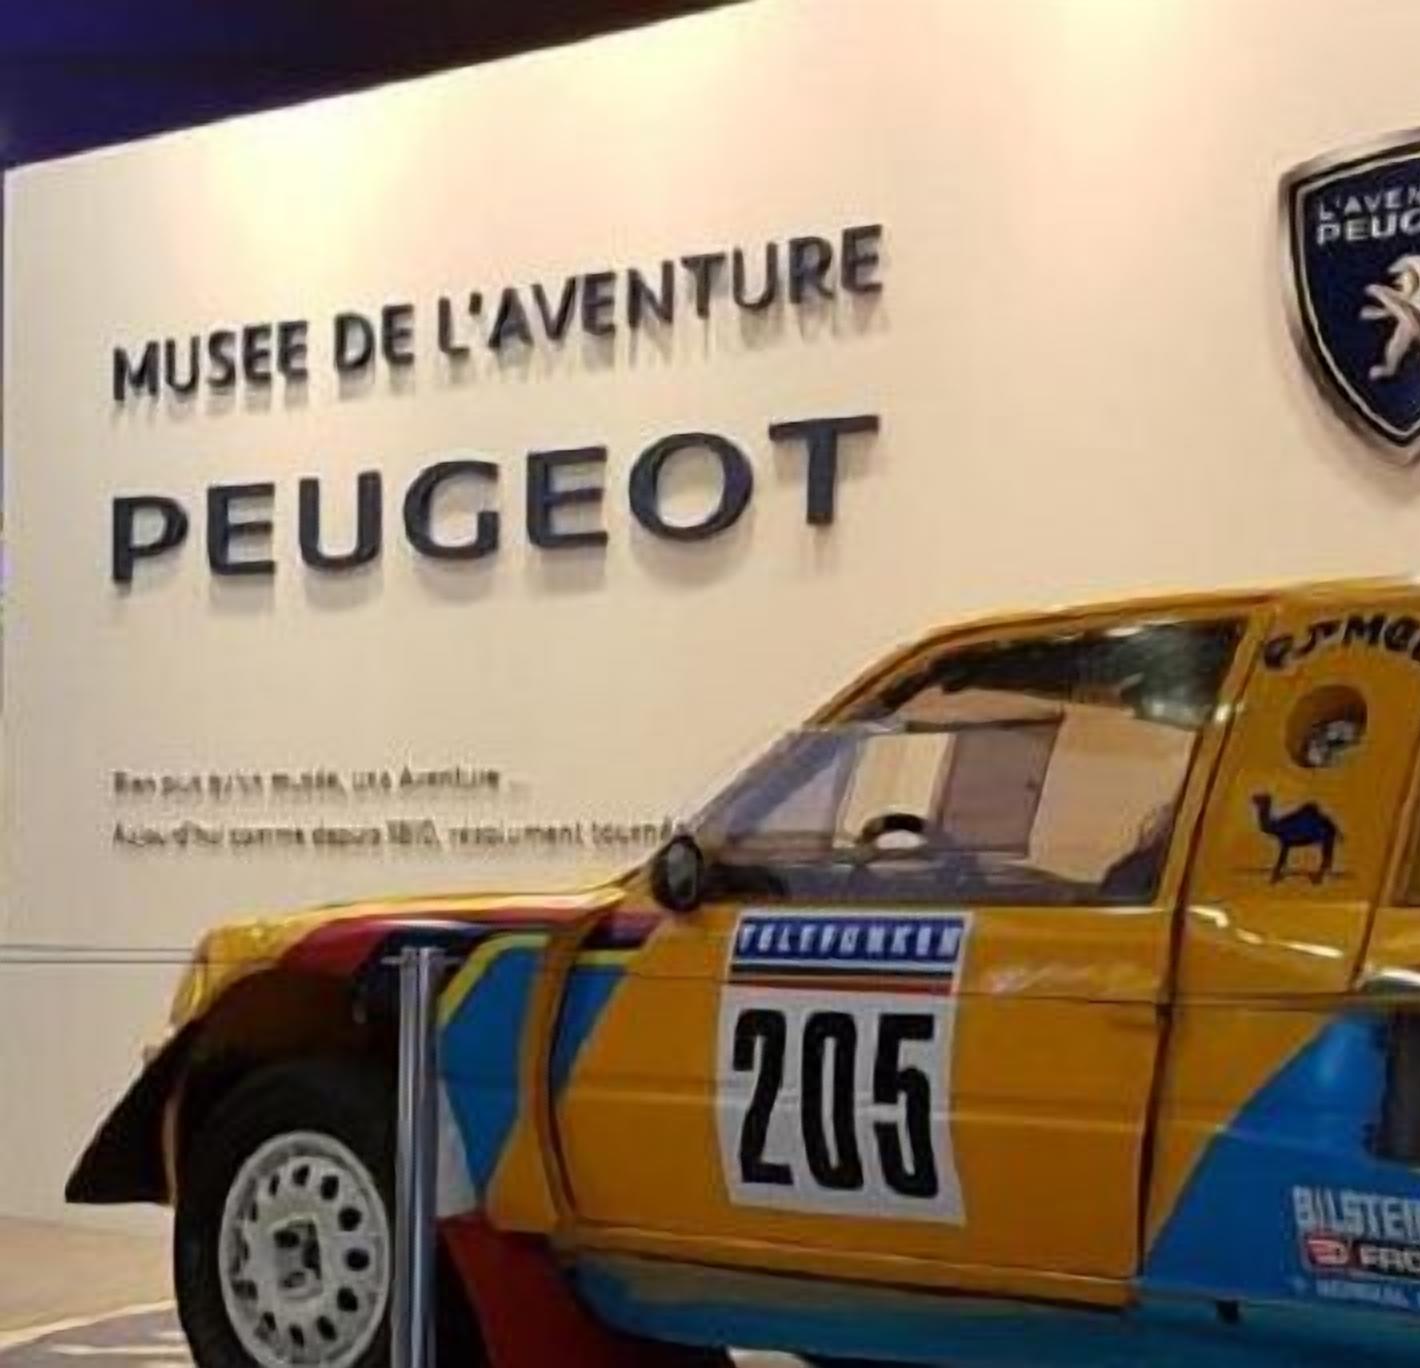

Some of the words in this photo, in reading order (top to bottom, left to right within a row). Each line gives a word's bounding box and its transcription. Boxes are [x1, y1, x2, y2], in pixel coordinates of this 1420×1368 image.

[113, 320, 308, 400] MUSEE
[334, 304, 415, 372] DE
[437, 224, 882, 357] L'AVENTURE
[111, 414, 880, 583] PEUGEOT
[733, 1009, 939, 1199] 205
